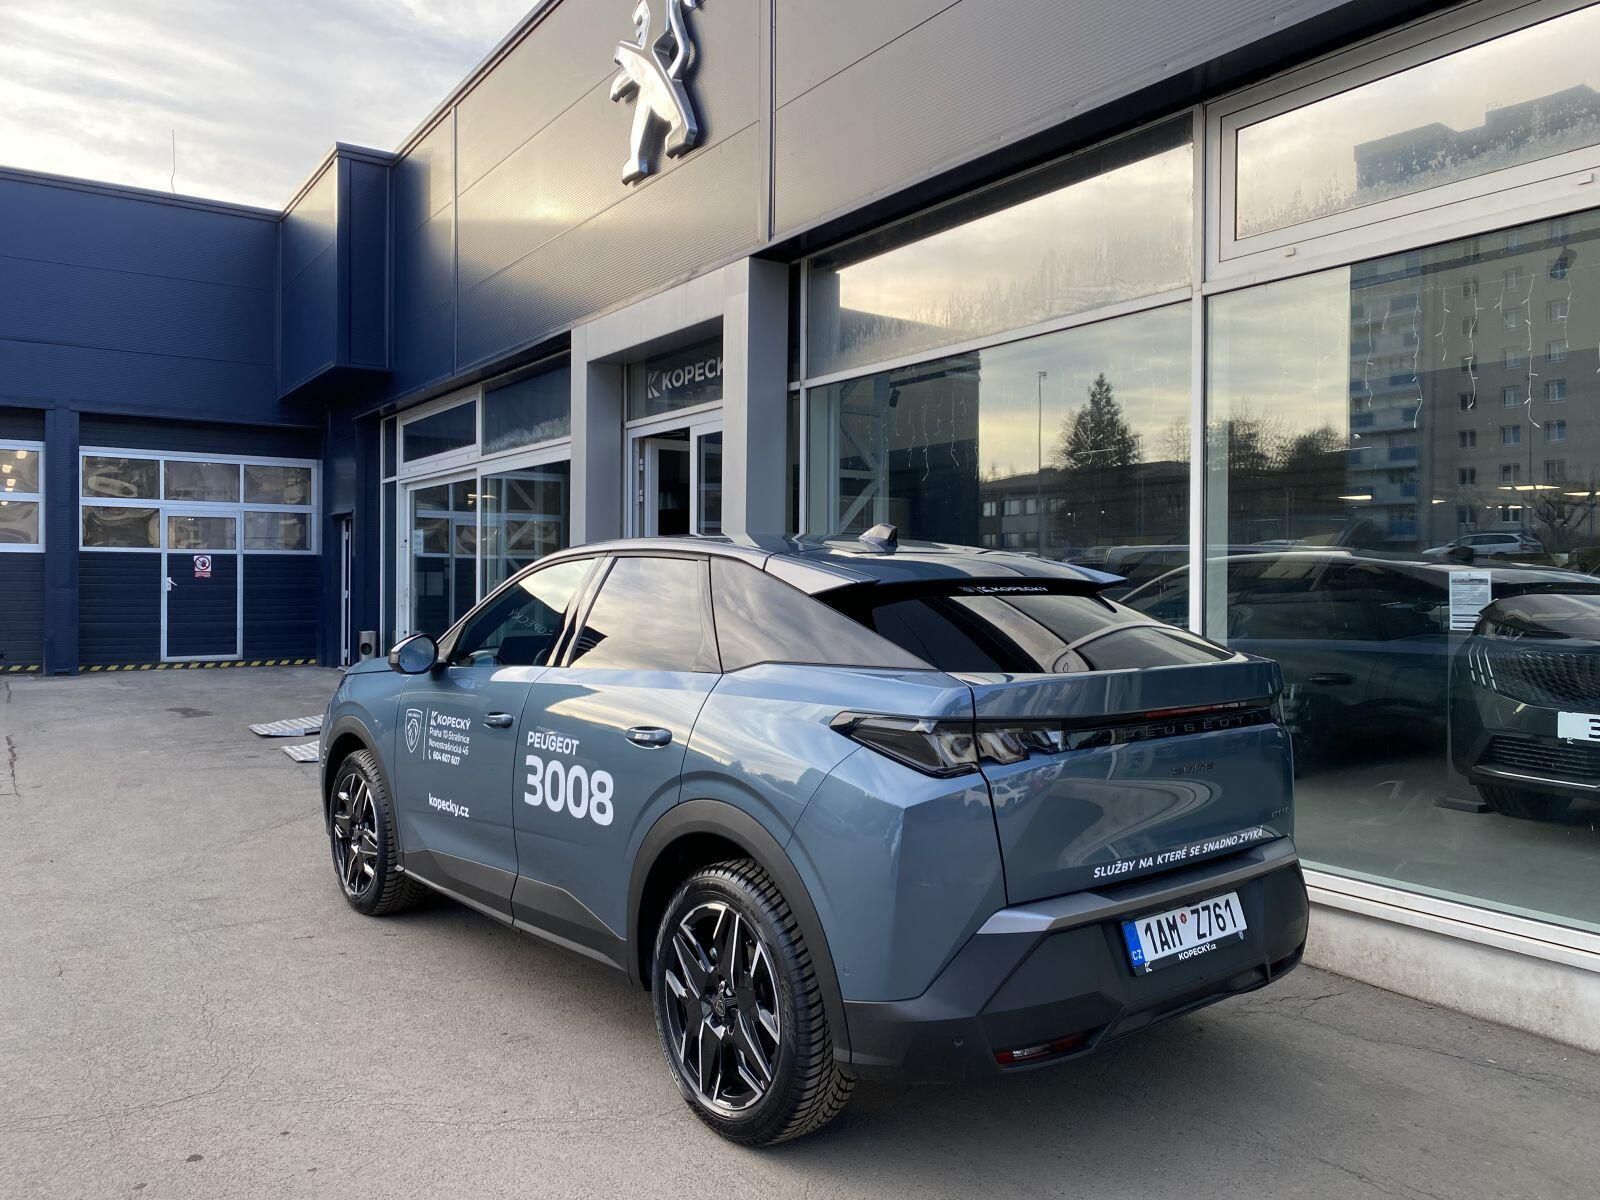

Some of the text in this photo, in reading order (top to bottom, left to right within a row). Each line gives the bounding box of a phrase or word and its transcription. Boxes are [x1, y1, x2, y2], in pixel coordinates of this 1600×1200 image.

[430, 727, 442, 738] Praha
[437, 714, 471, 730] KOPECKÝ
[527, 731, 580, 755] PEUGEOT
[524, 754, 614, 826] 3008
[428, 793, 470, 818] kopecky.cz
[1093, 857, 1136, 878] SLUŽBY
[1138, 857, 1154, 869] NA
[1156, 846, 1188, 865] KTERÉ
[1189, 845, 1201, 857] SE
[1202, 835, 1238, 854] SNADNO
[1144, 898, 1237, 954] 1AM Z761
[1131, 949, 1143, 961] CZ
